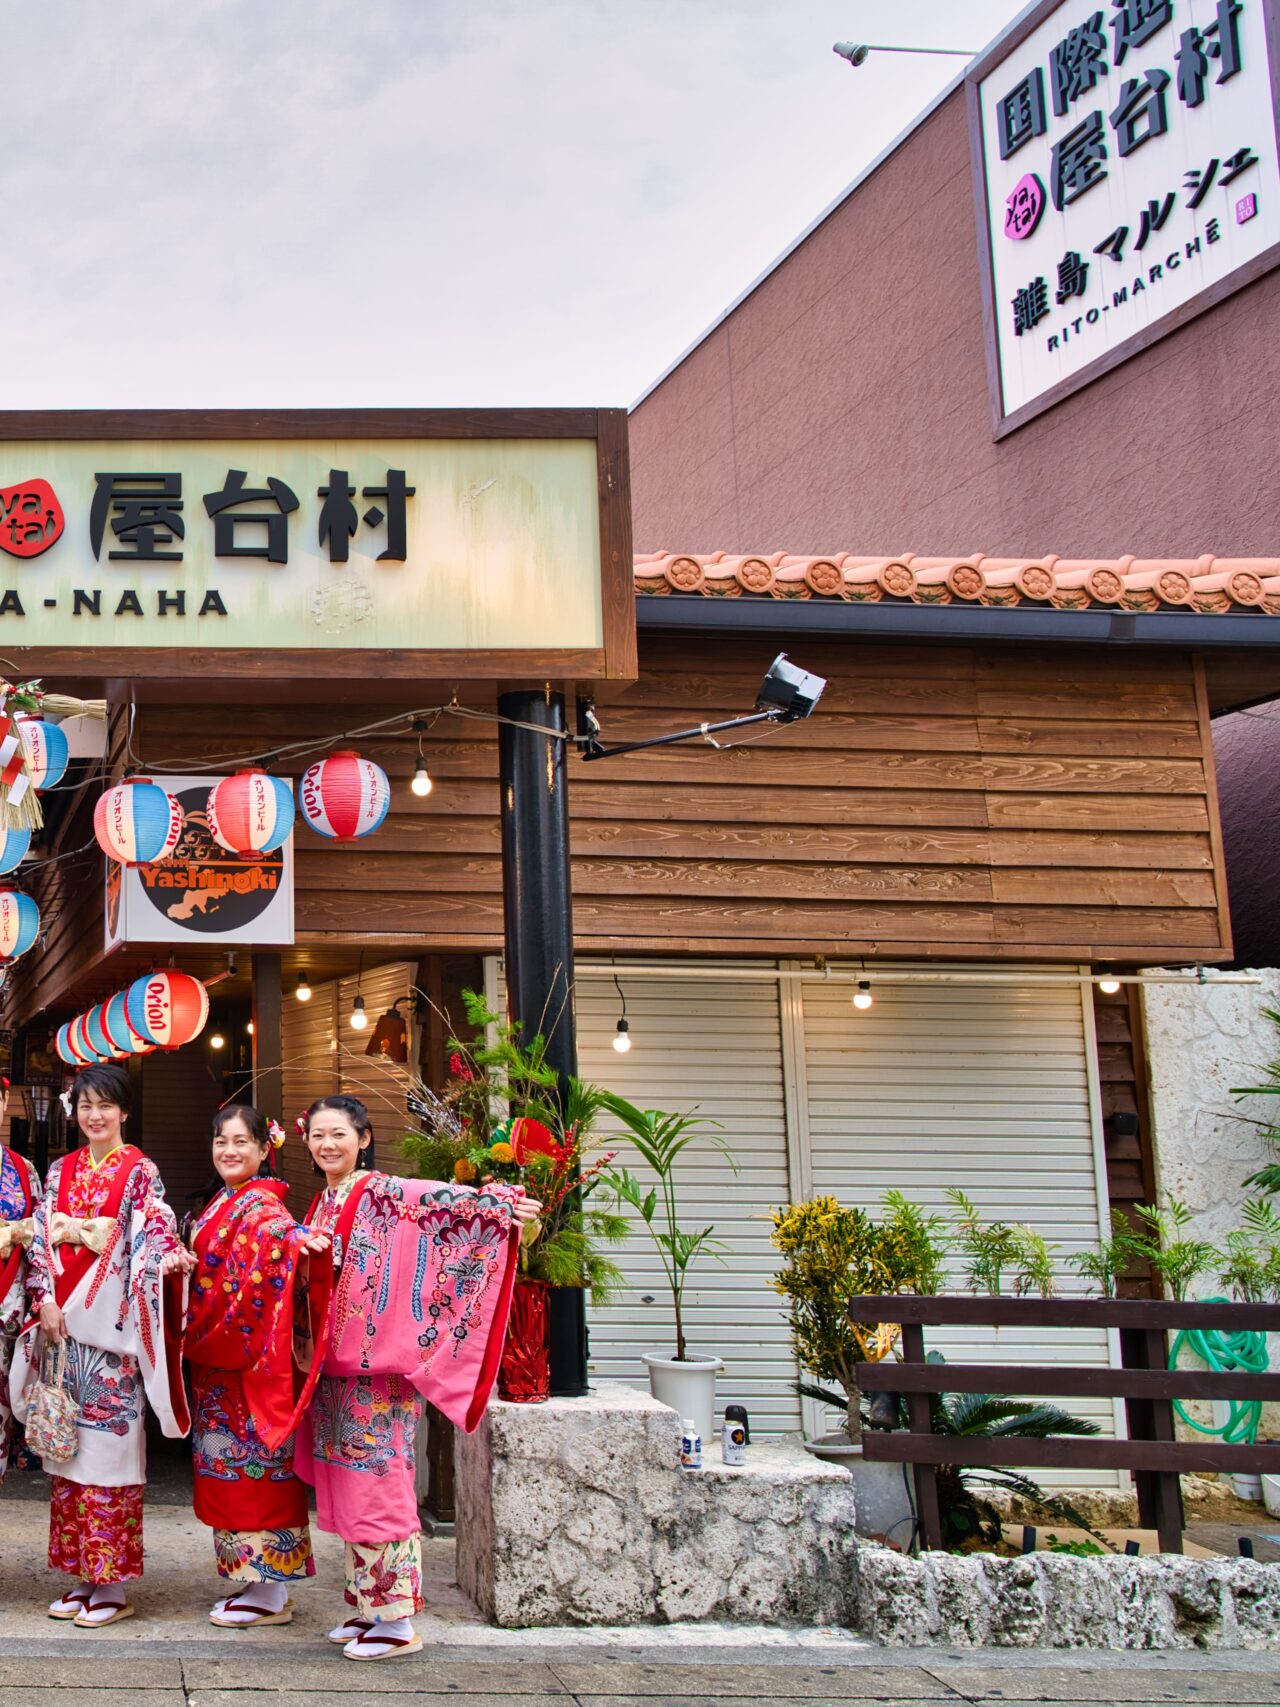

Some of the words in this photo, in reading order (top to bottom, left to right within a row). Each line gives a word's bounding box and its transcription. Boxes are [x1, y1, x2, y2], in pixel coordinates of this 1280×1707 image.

[1050, 2, 1243, 211] 屋台村
[1011, 148, 1259, 336] 離島マルシェ
[89, 468, 416, 564] 屋台村
[114, 791, 127, 845] オリオンビール
[254, 779, 266, 832] オリオンビール
[141, 867, 277, 890] Yashinoki
[1, 898, 10, 943] オリオンビール
